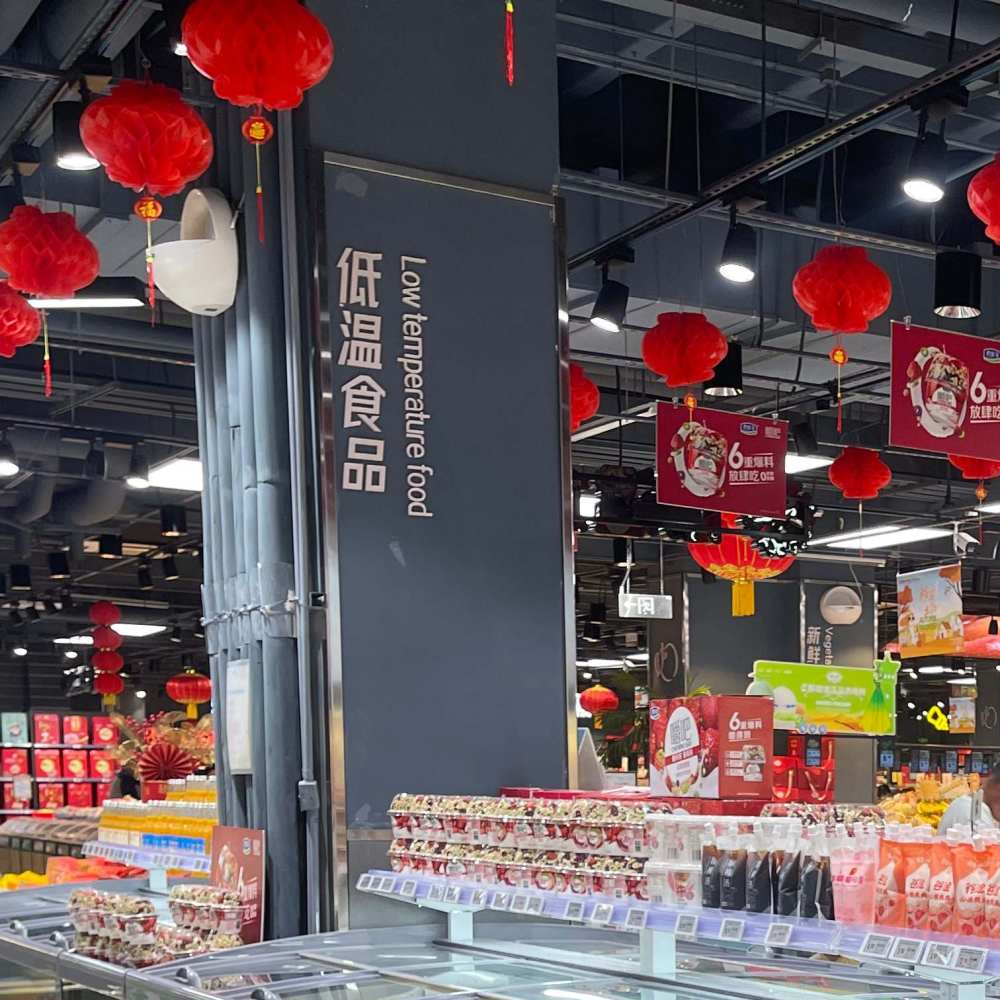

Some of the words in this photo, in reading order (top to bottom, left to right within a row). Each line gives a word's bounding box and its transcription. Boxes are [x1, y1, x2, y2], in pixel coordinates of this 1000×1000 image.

[401, 255, 427, 309] Low
[336, 247, 386, 493] 低温食品
[397, 312, 431, 459] temperature
[407, 464, 433, 518] food
